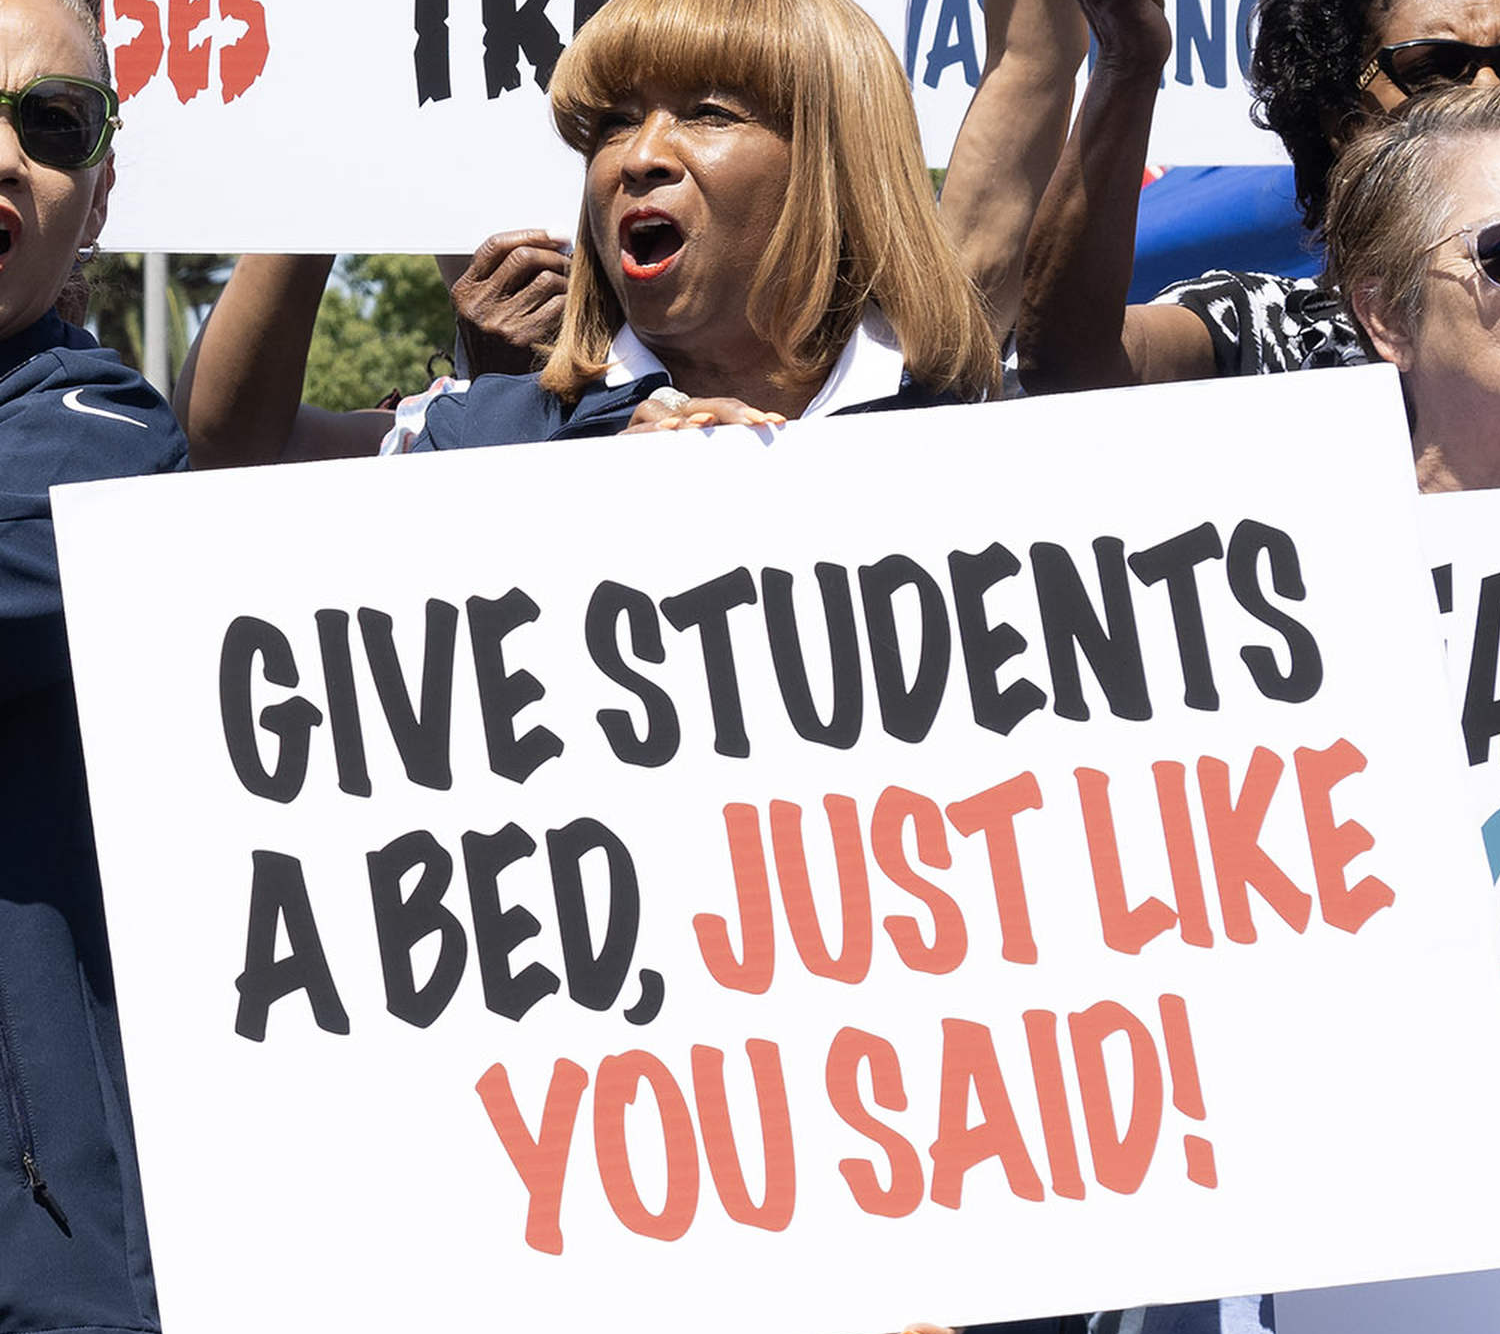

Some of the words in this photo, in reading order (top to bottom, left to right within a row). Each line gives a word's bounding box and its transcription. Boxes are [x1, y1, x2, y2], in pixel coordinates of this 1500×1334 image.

[219, 587, 564, 804] GIVE
[585, 519, 1323, 768] STUDENTS
[235, 850, 350, 1042] A
[366, 817, 664, 1029] BED,
[693, 771, 1043, 995] JUST
[1074, 738, 1395, 955] LIKE
[476, 1038, 796, 1255] YOU
[826, 993, 1217, 1218] SAID!
